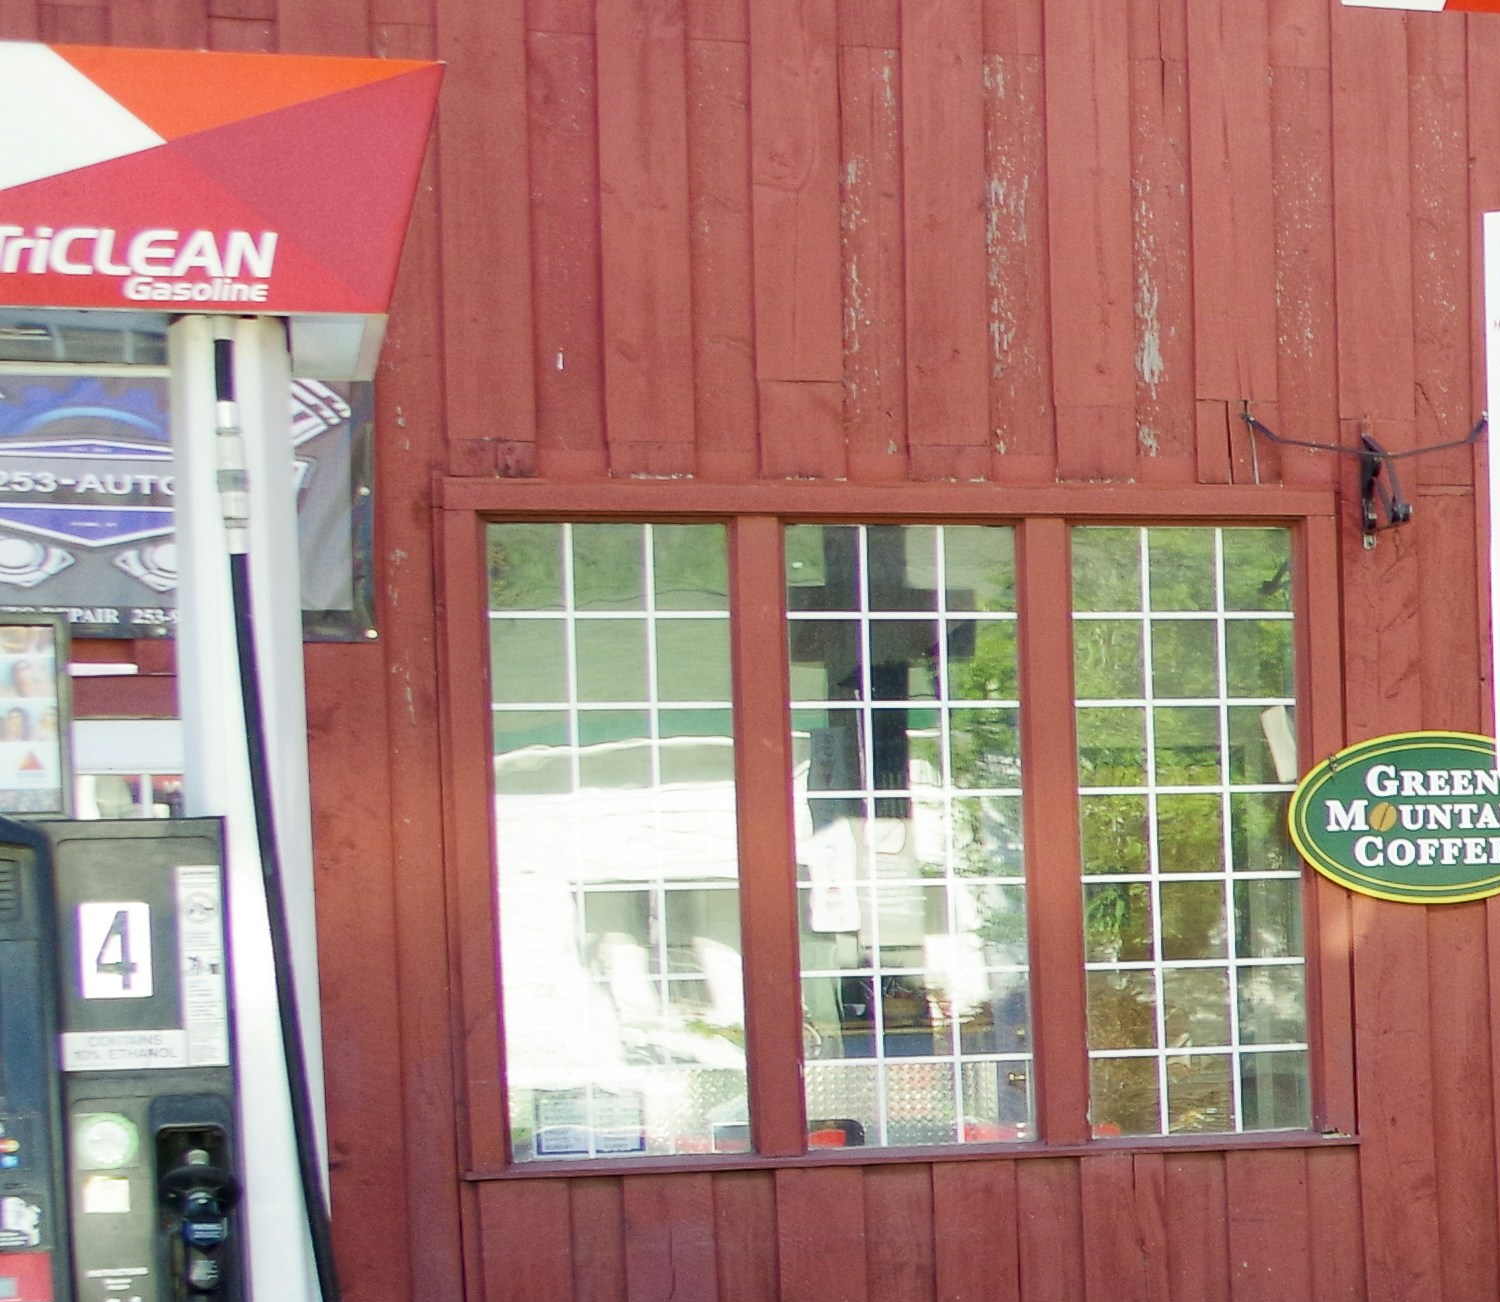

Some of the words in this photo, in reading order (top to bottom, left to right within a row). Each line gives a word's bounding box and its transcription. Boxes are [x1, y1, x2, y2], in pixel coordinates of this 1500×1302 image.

[124, 277, 267, 302] Gasoline
[1366, 764, 1499, 798] GREEN
[97, 910, 136, 990] 4
[88, 1035, 162, 1047] CONTAINS
